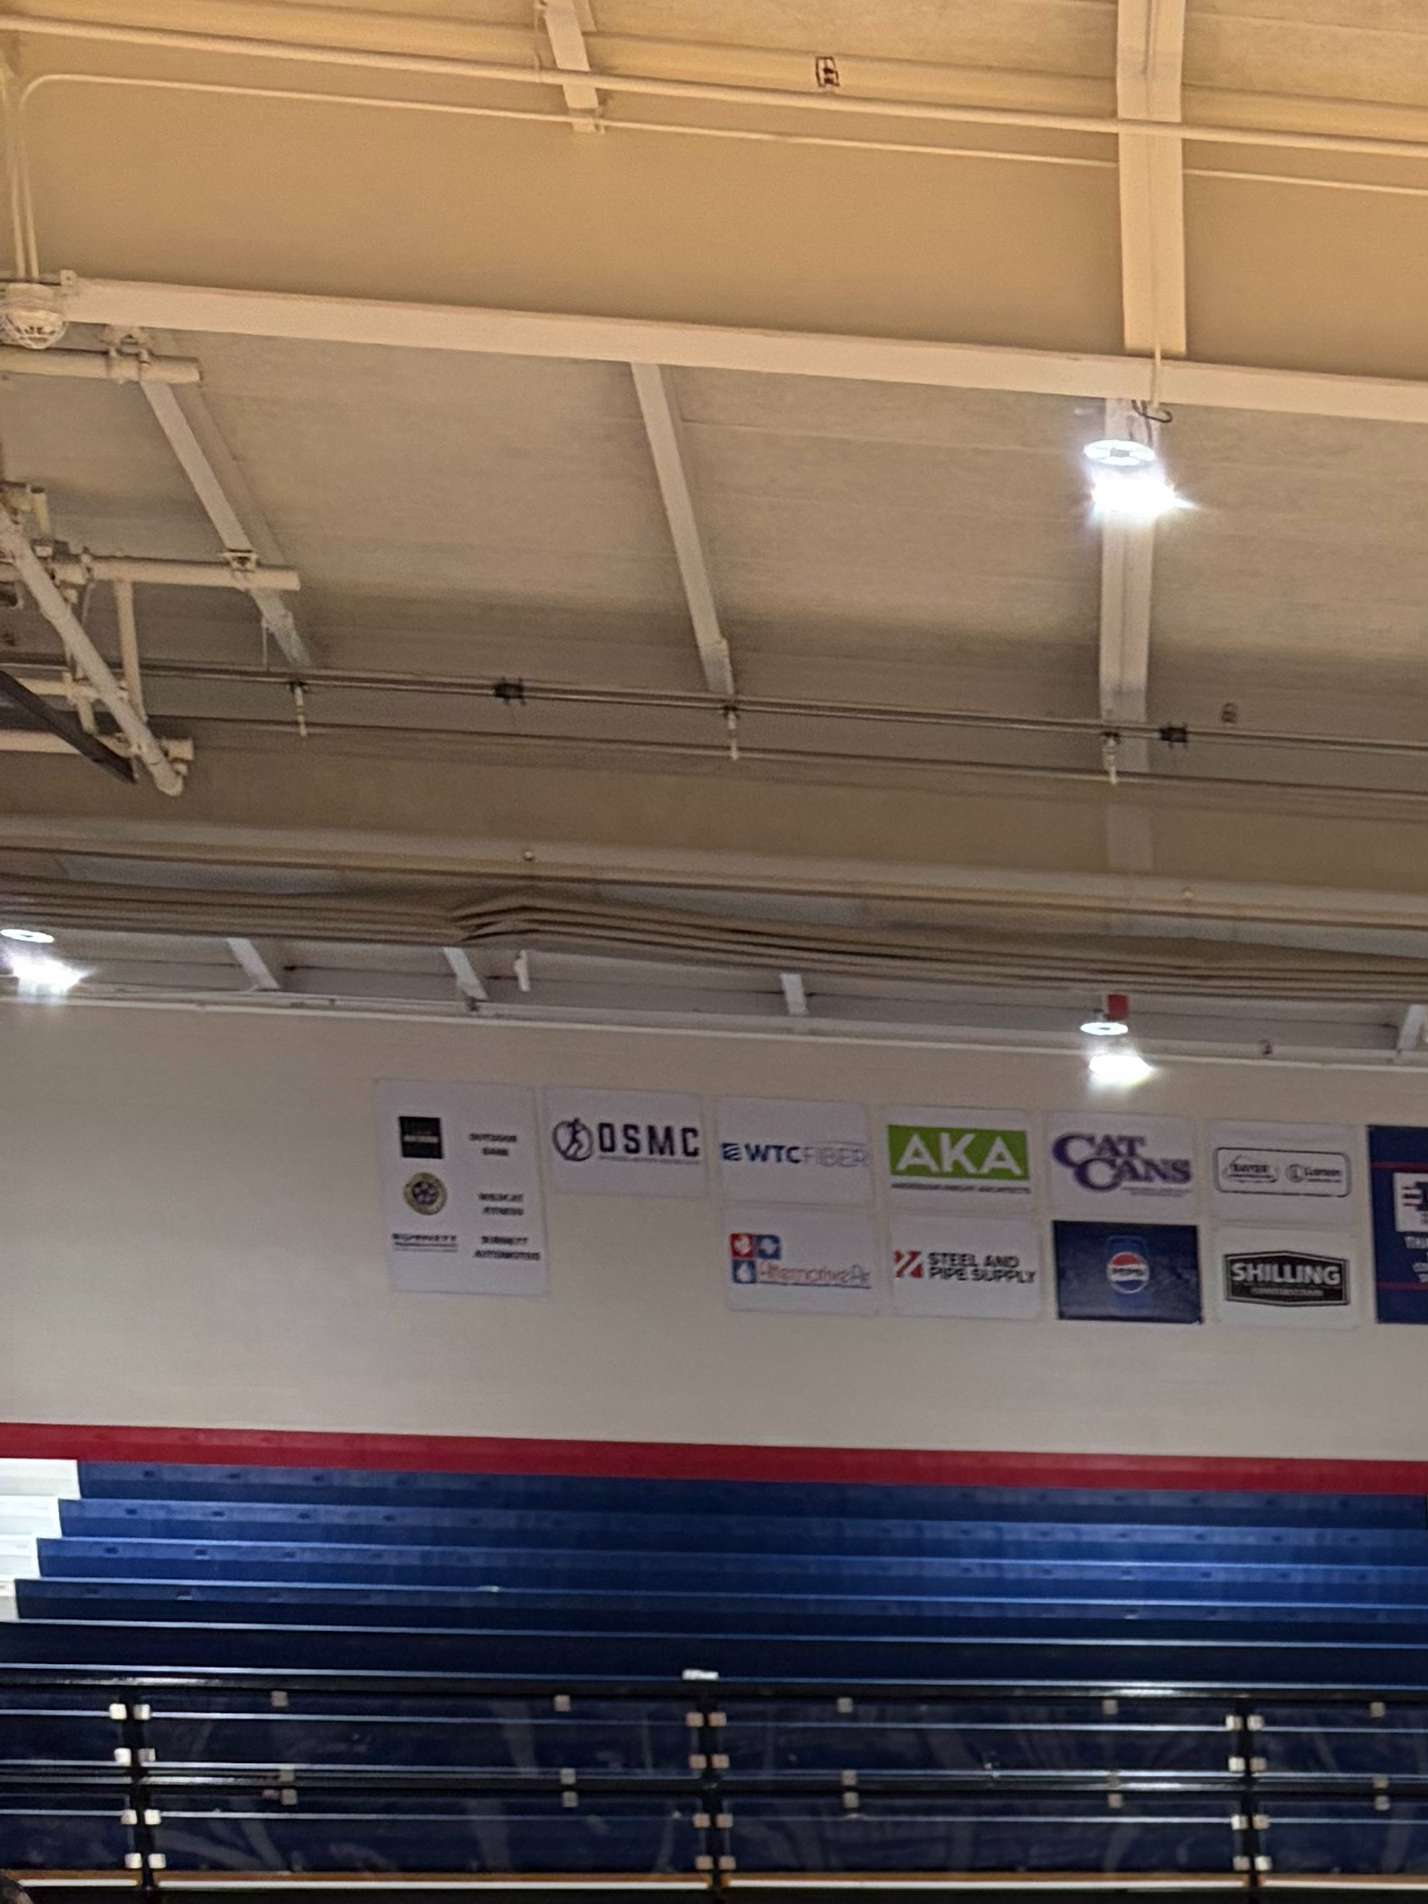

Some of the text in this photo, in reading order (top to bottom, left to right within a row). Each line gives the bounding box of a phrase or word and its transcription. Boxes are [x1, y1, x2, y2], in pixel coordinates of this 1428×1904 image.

[895, 1131, 1024, 1176] AKA
[1052, 1132, 1146, 1170] CAT
[1074, 1156, 1193, 1192] CANS
[928, 1252, 1020, 1269] STEEL AND
[928, 1267, 1037, 1284] PIPE SUPPLY
[1231, 1261, 1342, 1286] SHILLING
